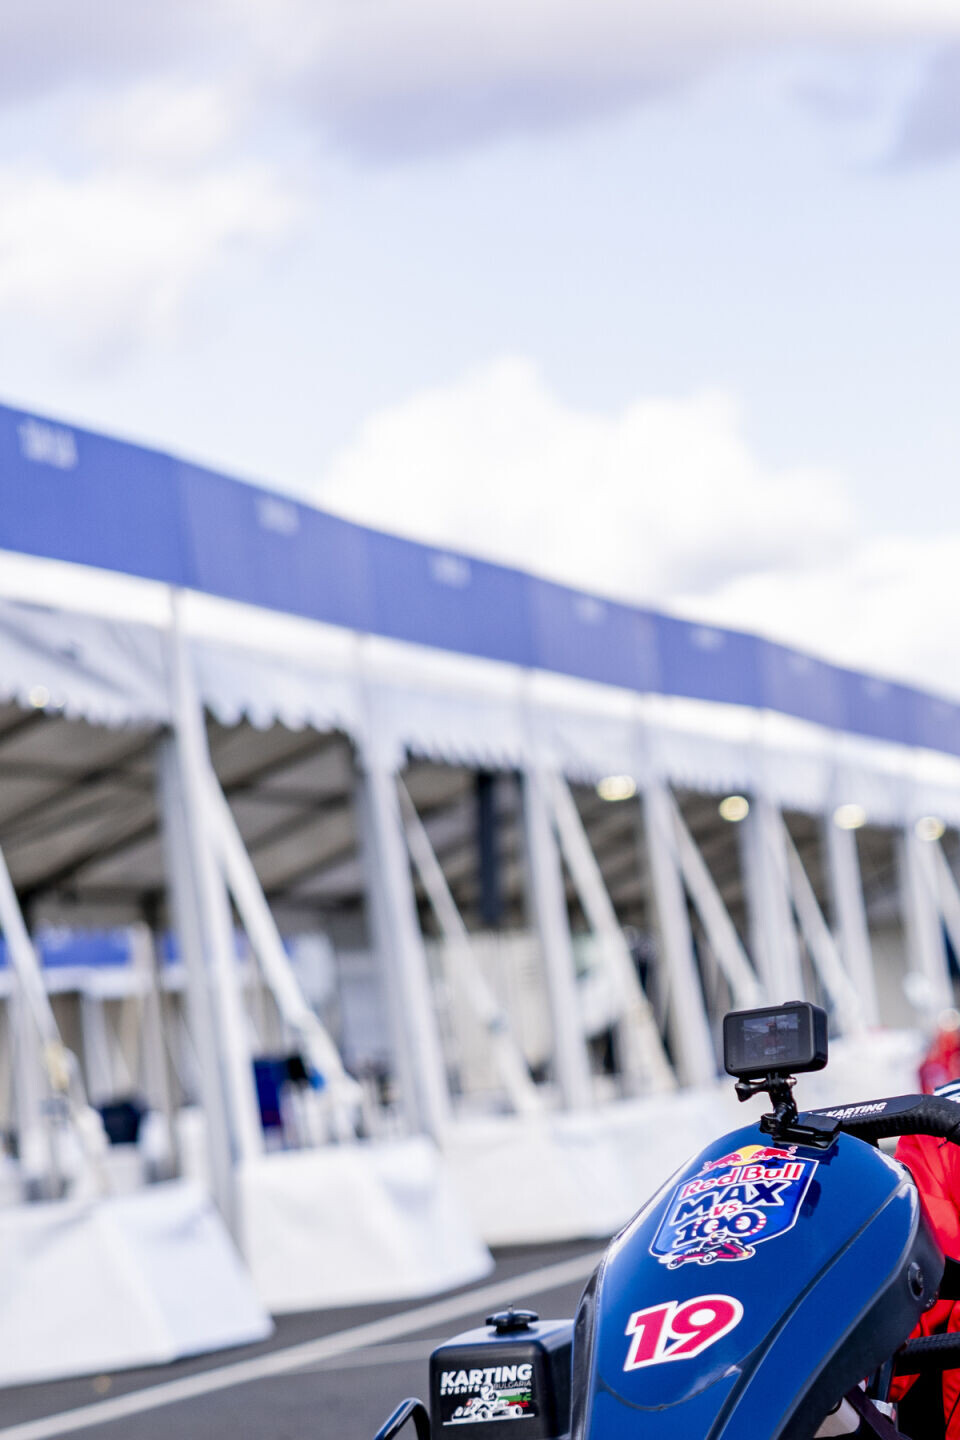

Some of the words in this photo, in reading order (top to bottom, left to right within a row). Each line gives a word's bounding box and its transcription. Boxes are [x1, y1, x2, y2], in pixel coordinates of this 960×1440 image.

[826, 1102, 888, 1118] KARTING
[681, 1166, 739, 1198] Red
[739, 1163, 804, 1182] Bull
[670, 1180, 792, 1226] MAX
[673, 1209, 767, 1248] 100
[626, 1295, 742, 1370] 19
[440, 1384, 480, 1396] EVENTS
[441, 1364, 532, 1388] KARTING
